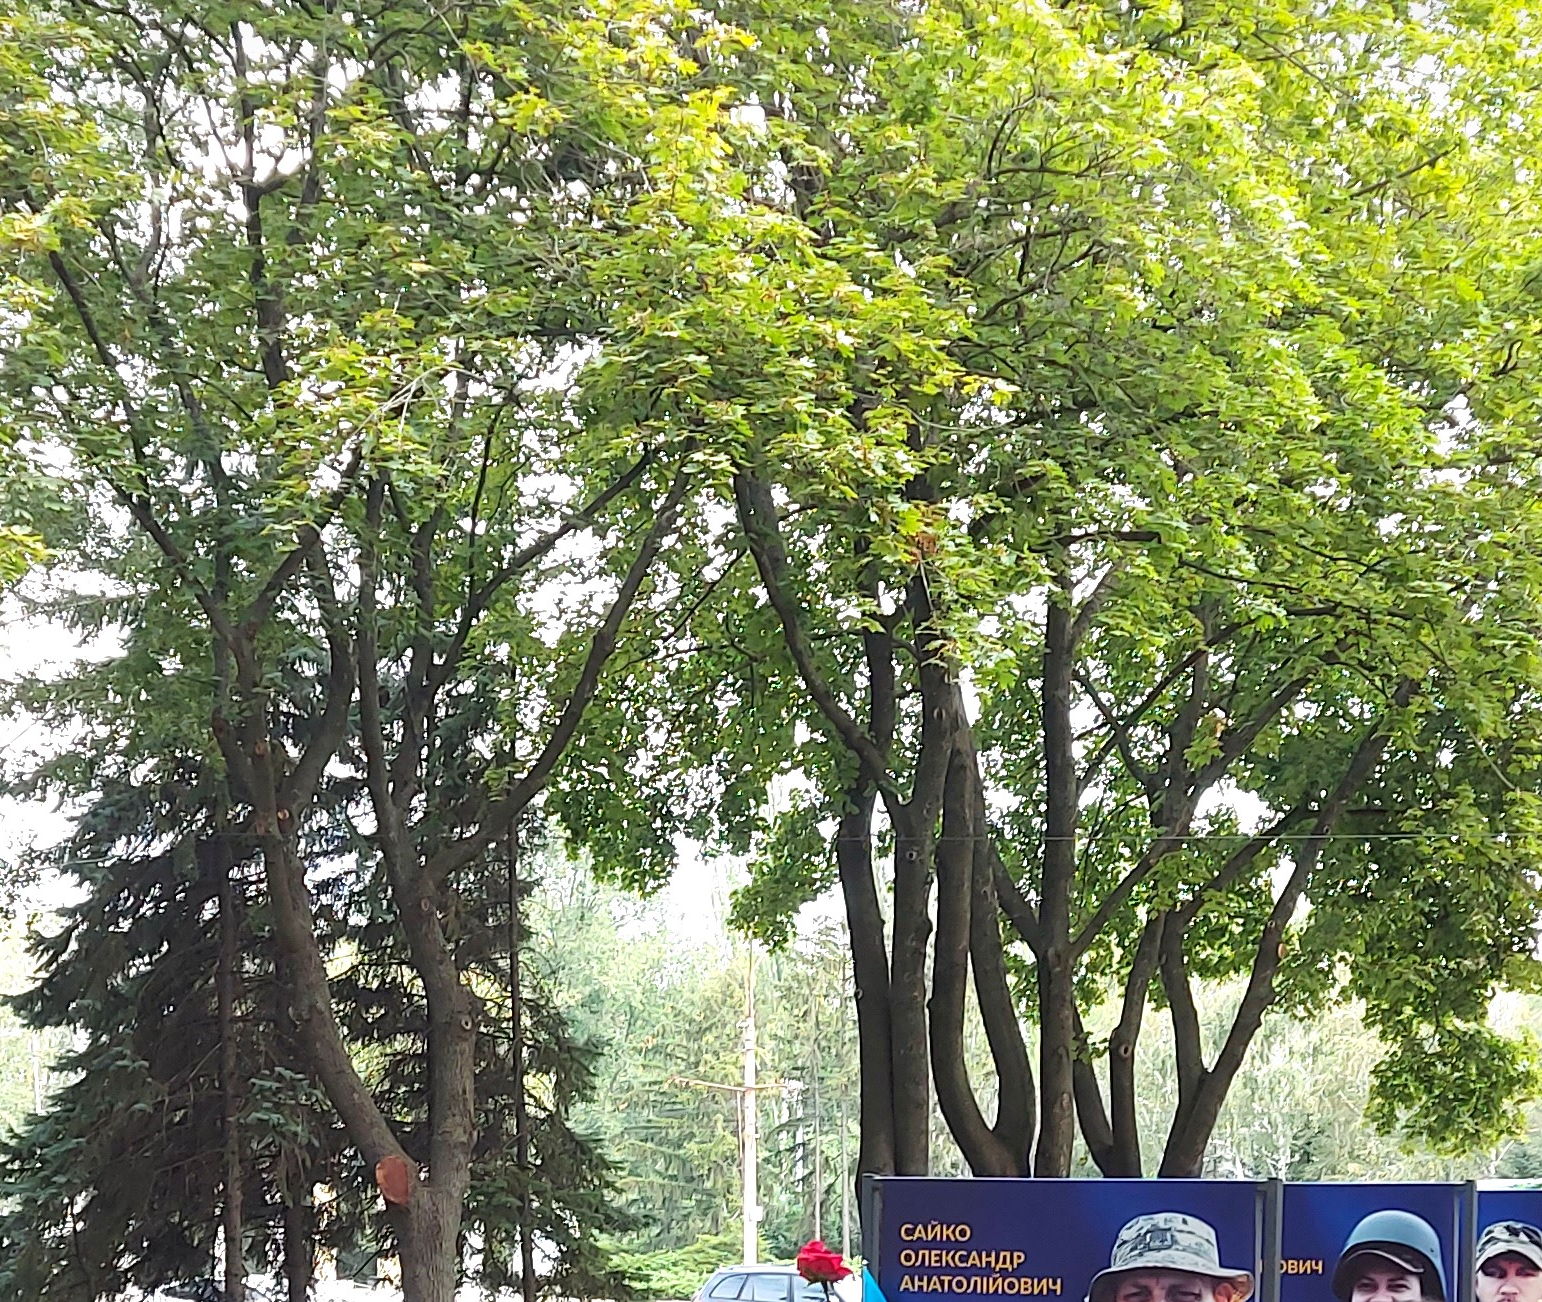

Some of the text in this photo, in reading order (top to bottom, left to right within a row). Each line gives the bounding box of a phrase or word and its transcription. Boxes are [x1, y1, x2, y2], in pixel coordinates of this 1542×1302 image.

[900, 1221, 971, 1241] САЙКО
[900, 1250, 1025, 1272] ОЛЕКСАНДР
[899, 1273, 1062, 1295] АНАТОЛІЙОВИЧ
